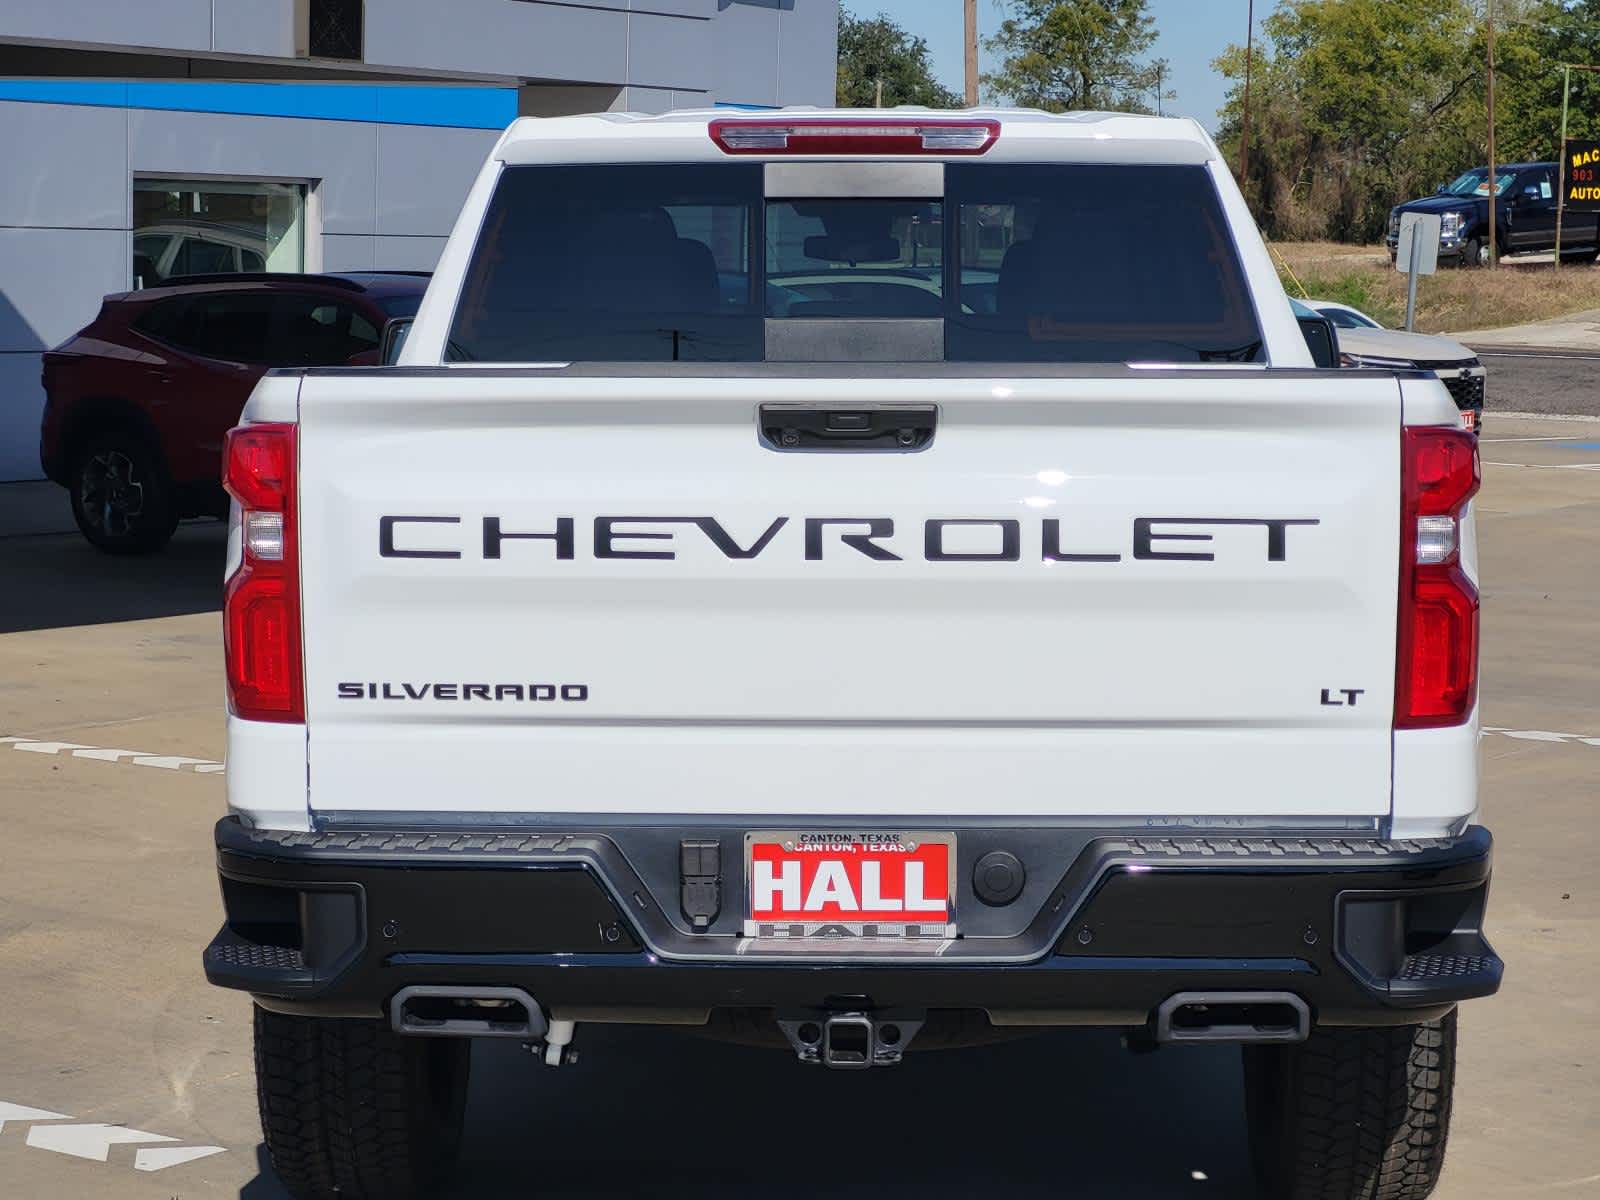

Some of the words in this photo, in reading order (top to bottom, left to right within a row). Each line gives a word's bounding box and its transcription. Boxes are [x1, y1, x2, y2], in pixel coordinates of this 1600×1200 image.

[1572, 169, 1593, 181] 903
[1570, 186, 1600, 200] AUTO
[380, 517, 1320, 562] CHEVROLET
[338, 683, 589, 701] SILVERADO
[1321, 689, 1364, 705] LT
[859, 833, 901, 843] TEXAS
[794, 842, 857, 854] CANTON,
[861, 842, 906, 853] TEXAS
[753, 860, 948, 911] HALL
